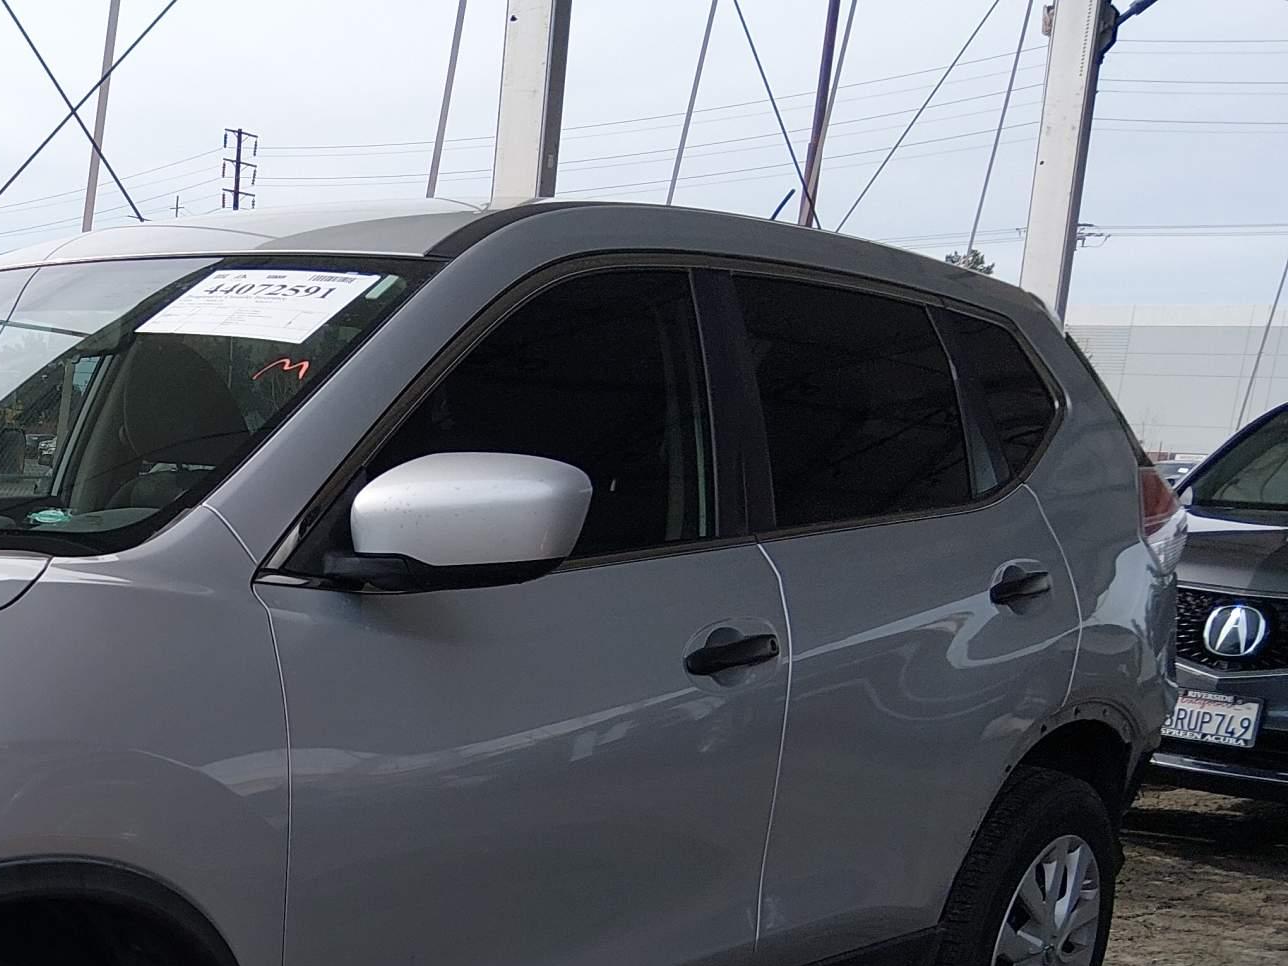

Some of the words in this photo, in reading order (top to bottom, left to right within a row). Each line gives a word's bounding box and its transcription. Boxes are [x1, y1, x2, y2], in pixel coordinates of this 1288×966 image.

[203, 283, 337, 299] 44072591
[1187, 690, 1235, 702] RIVERSIDE
[1161, 728, 1202, 740] SPREEN
[1203, 735, 1245, 746] ACURA
